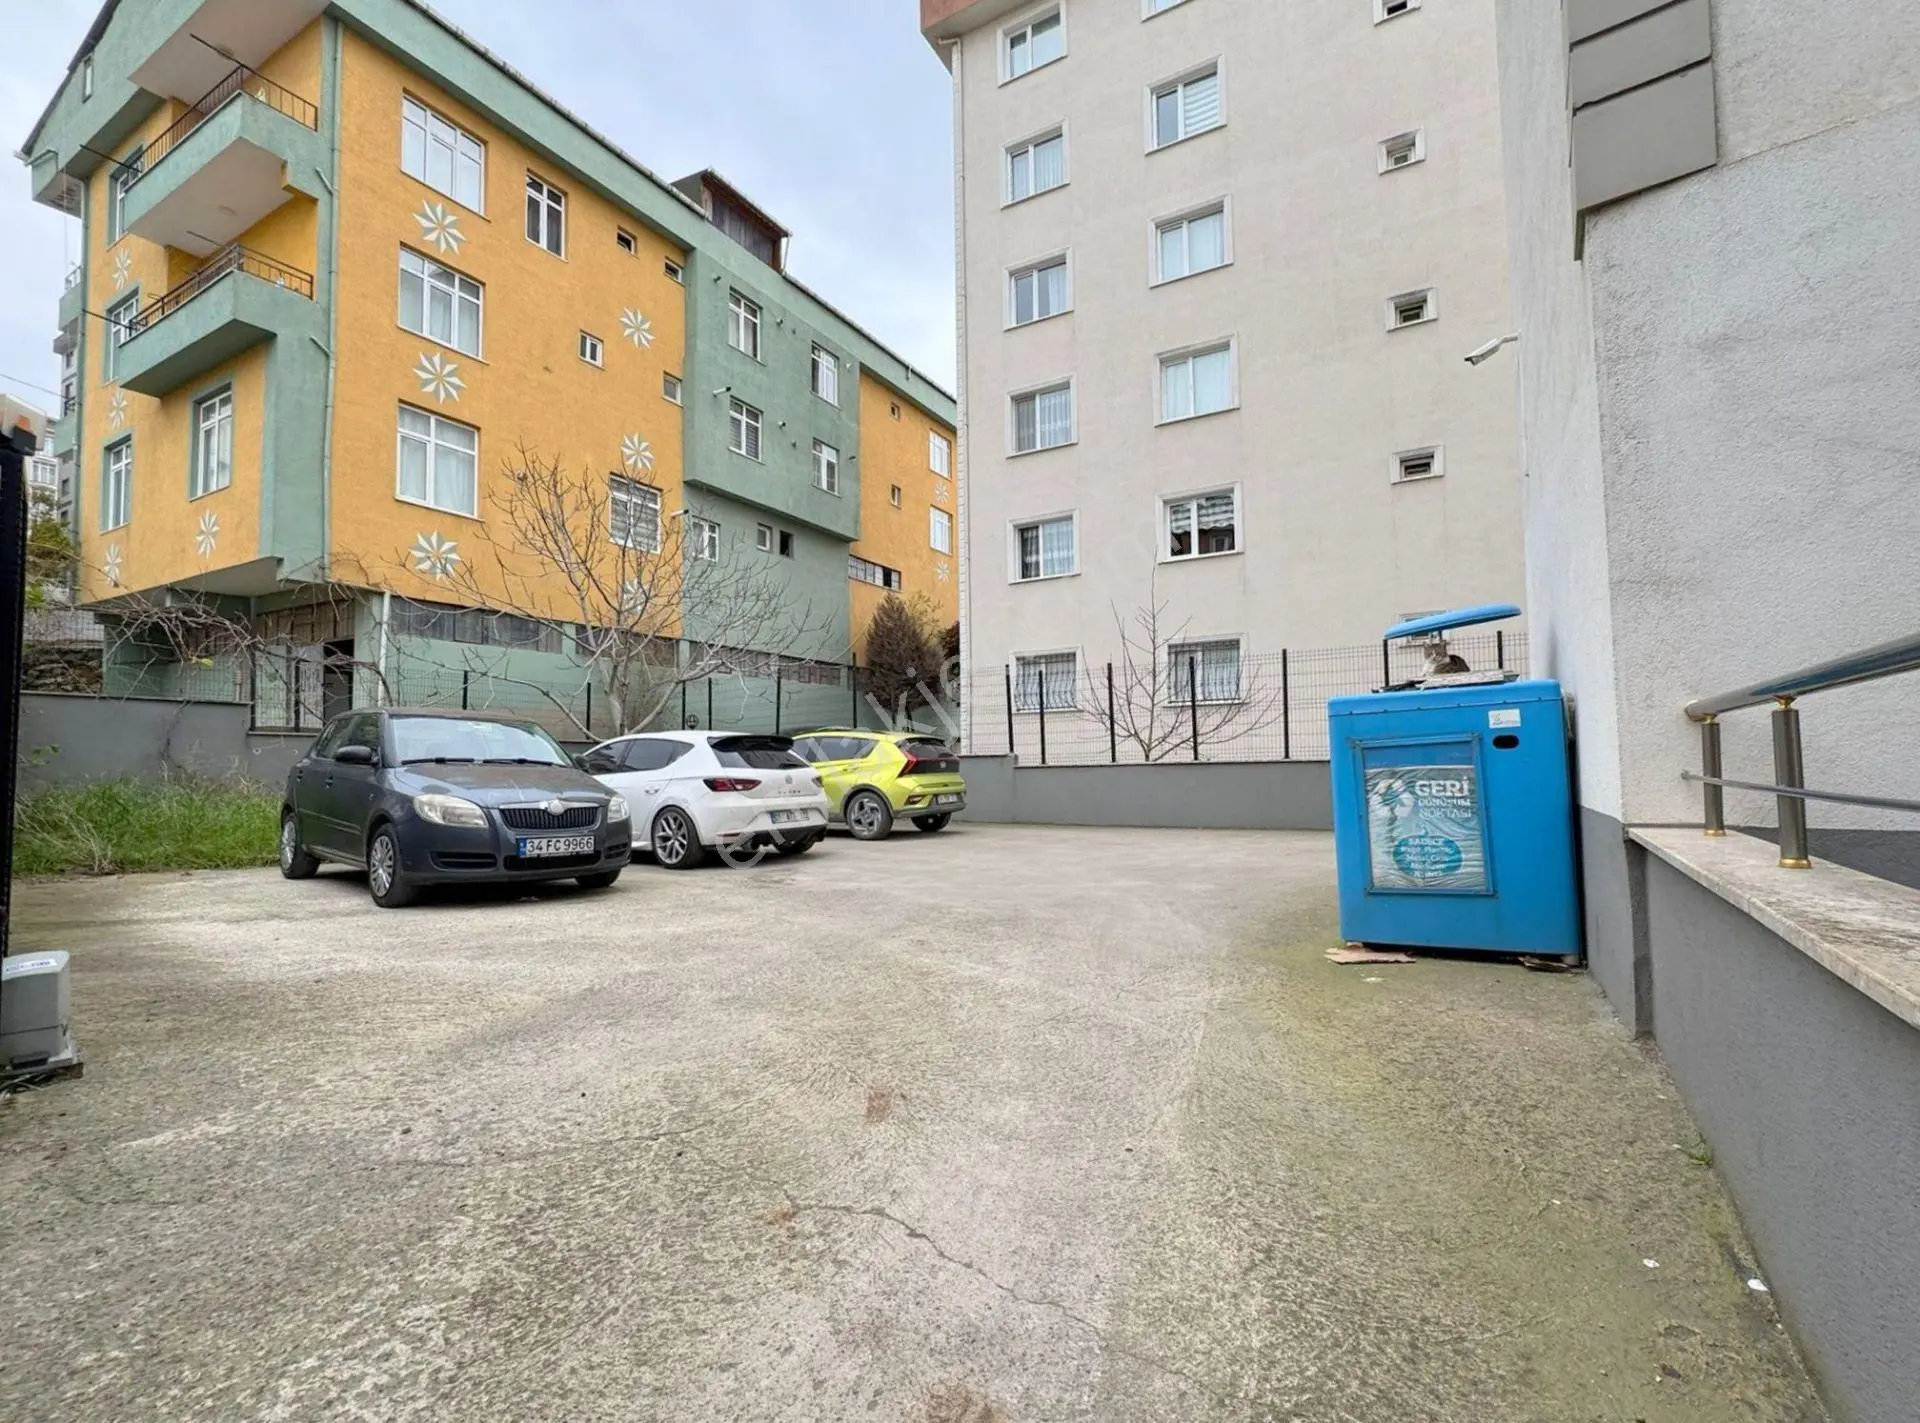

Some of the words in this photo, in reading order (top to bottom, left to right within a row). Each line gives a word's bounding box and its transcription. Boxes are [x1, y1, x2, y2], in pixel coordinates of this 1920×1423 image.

[1414, 776, 1469, 797] GERİ
[527, 840, 543, 853] 34
[546, 839, 561, 852] FC
[563, 837, 593, 851] 9966
